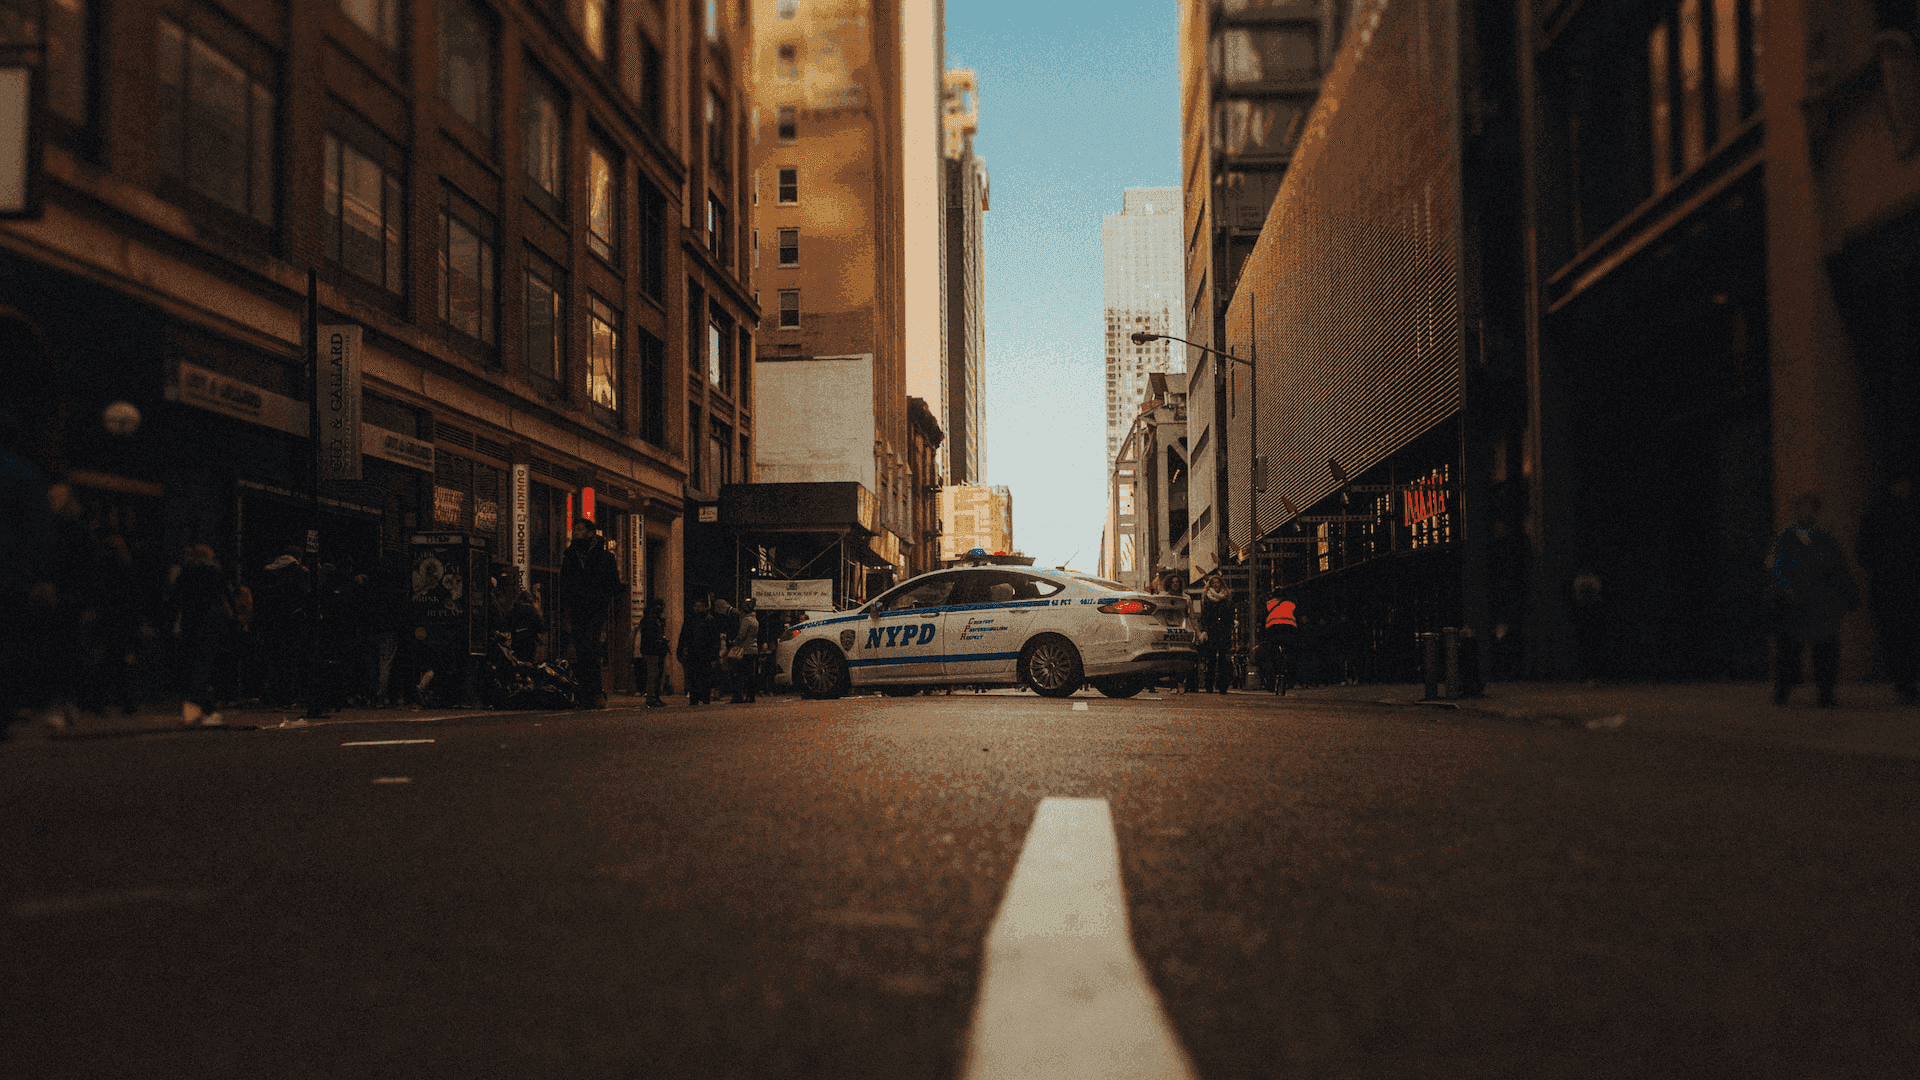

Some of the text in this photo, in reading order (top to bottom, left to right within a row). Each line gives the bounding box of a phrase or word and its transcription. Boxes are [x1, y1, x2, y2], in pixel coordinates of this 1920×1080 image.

[329, 333, 343, 412] GALLARD
[329, 418, 343, 430] &
[517, 469, 526, 512] DUNKIN'
[517, 524, 526, 565] DONUTS
[864, 623, 936, 649] NYPD
